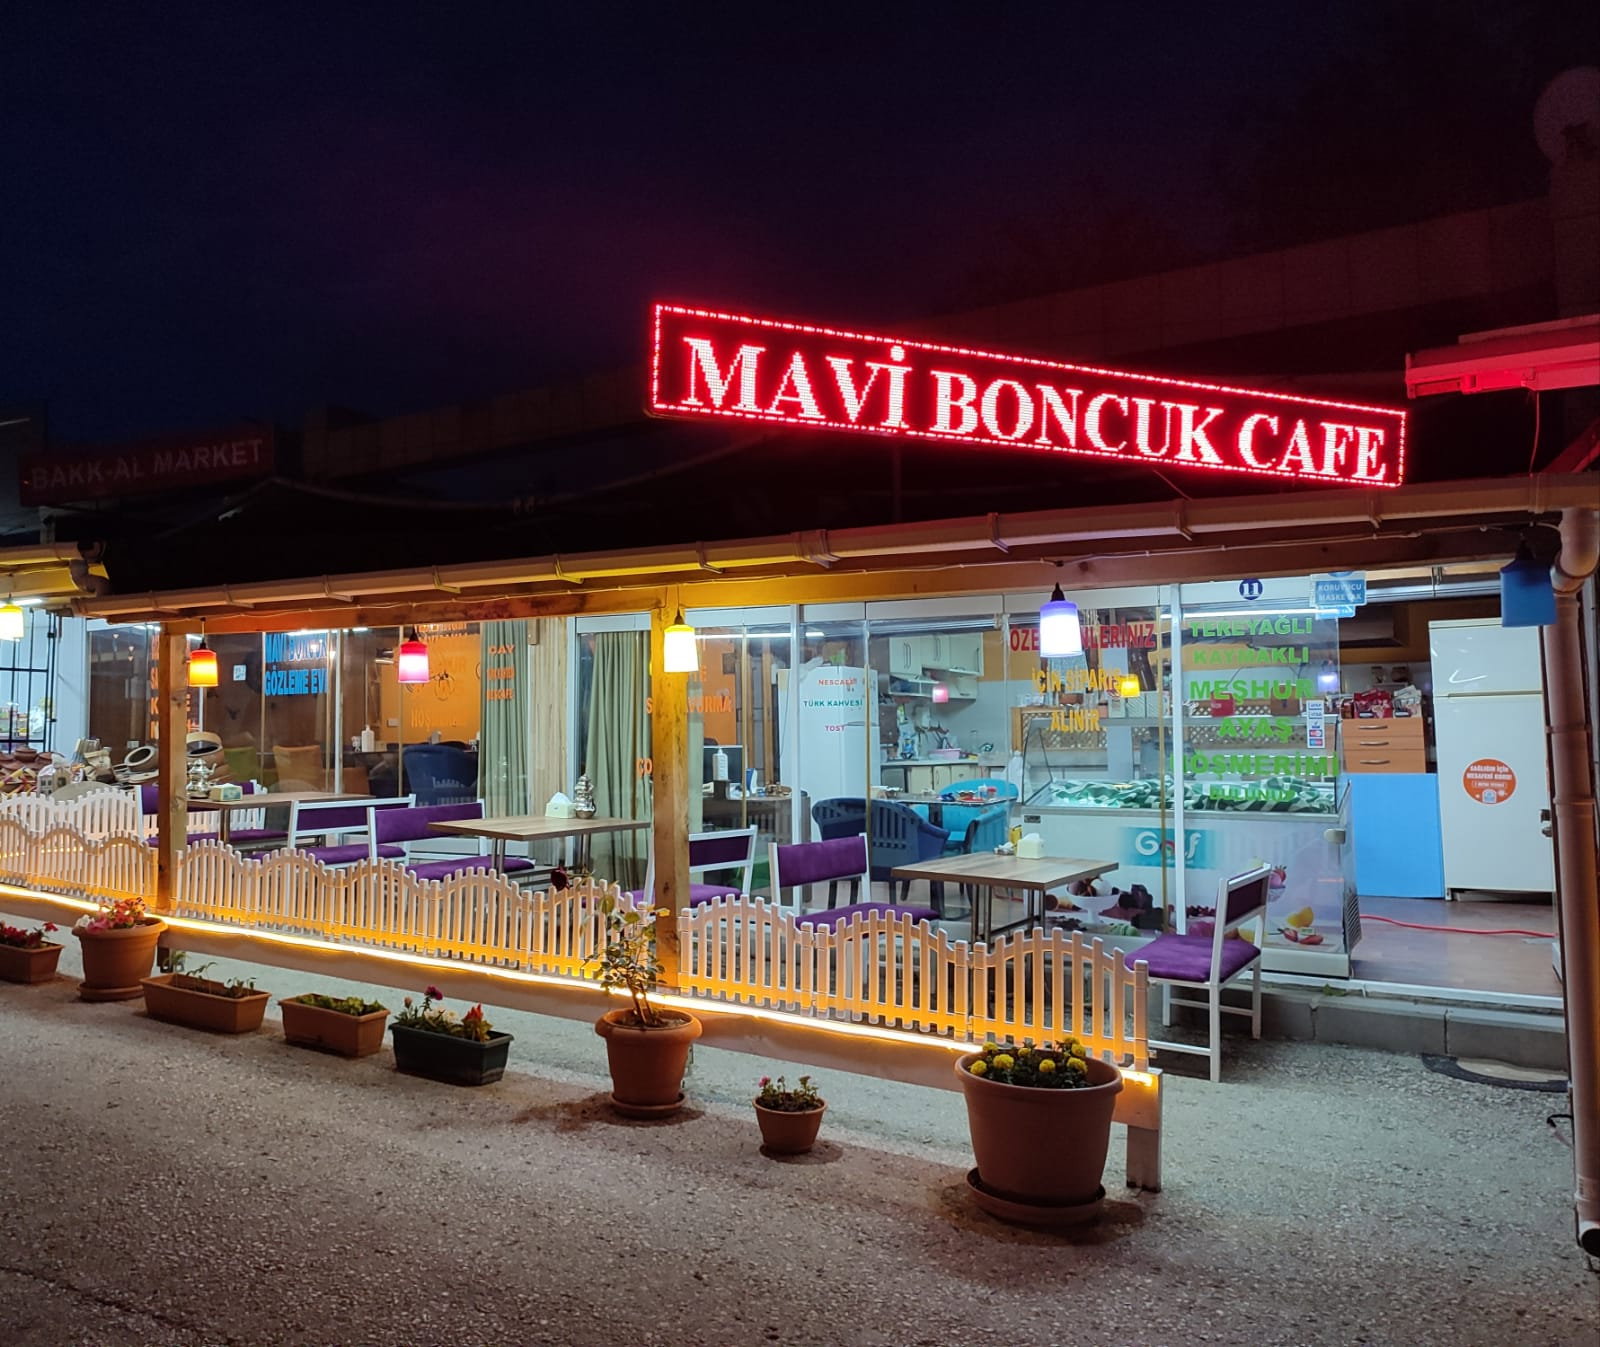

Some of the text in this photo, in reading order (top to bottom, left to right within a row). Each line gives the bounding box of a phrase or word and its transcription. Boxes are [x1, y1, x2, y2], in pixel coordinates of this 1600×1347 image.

[681, 336, 1386, 481] MAVİ BONCUK CAFE
[31, 439, 263, 489] BAKK-AL MARKET
[1010, 623, 1041, 651] ÖZE
[1190, 615, 1313, 637] TEREYAĞLI
[1193, 647, 1309, 665] KAYMAKLI
[265, 665, 309, 696] GÖZLEME
[1189, 679, 1315, 705] MEŞHUR
[1217, 717, 1294, 744] AYAŞ
